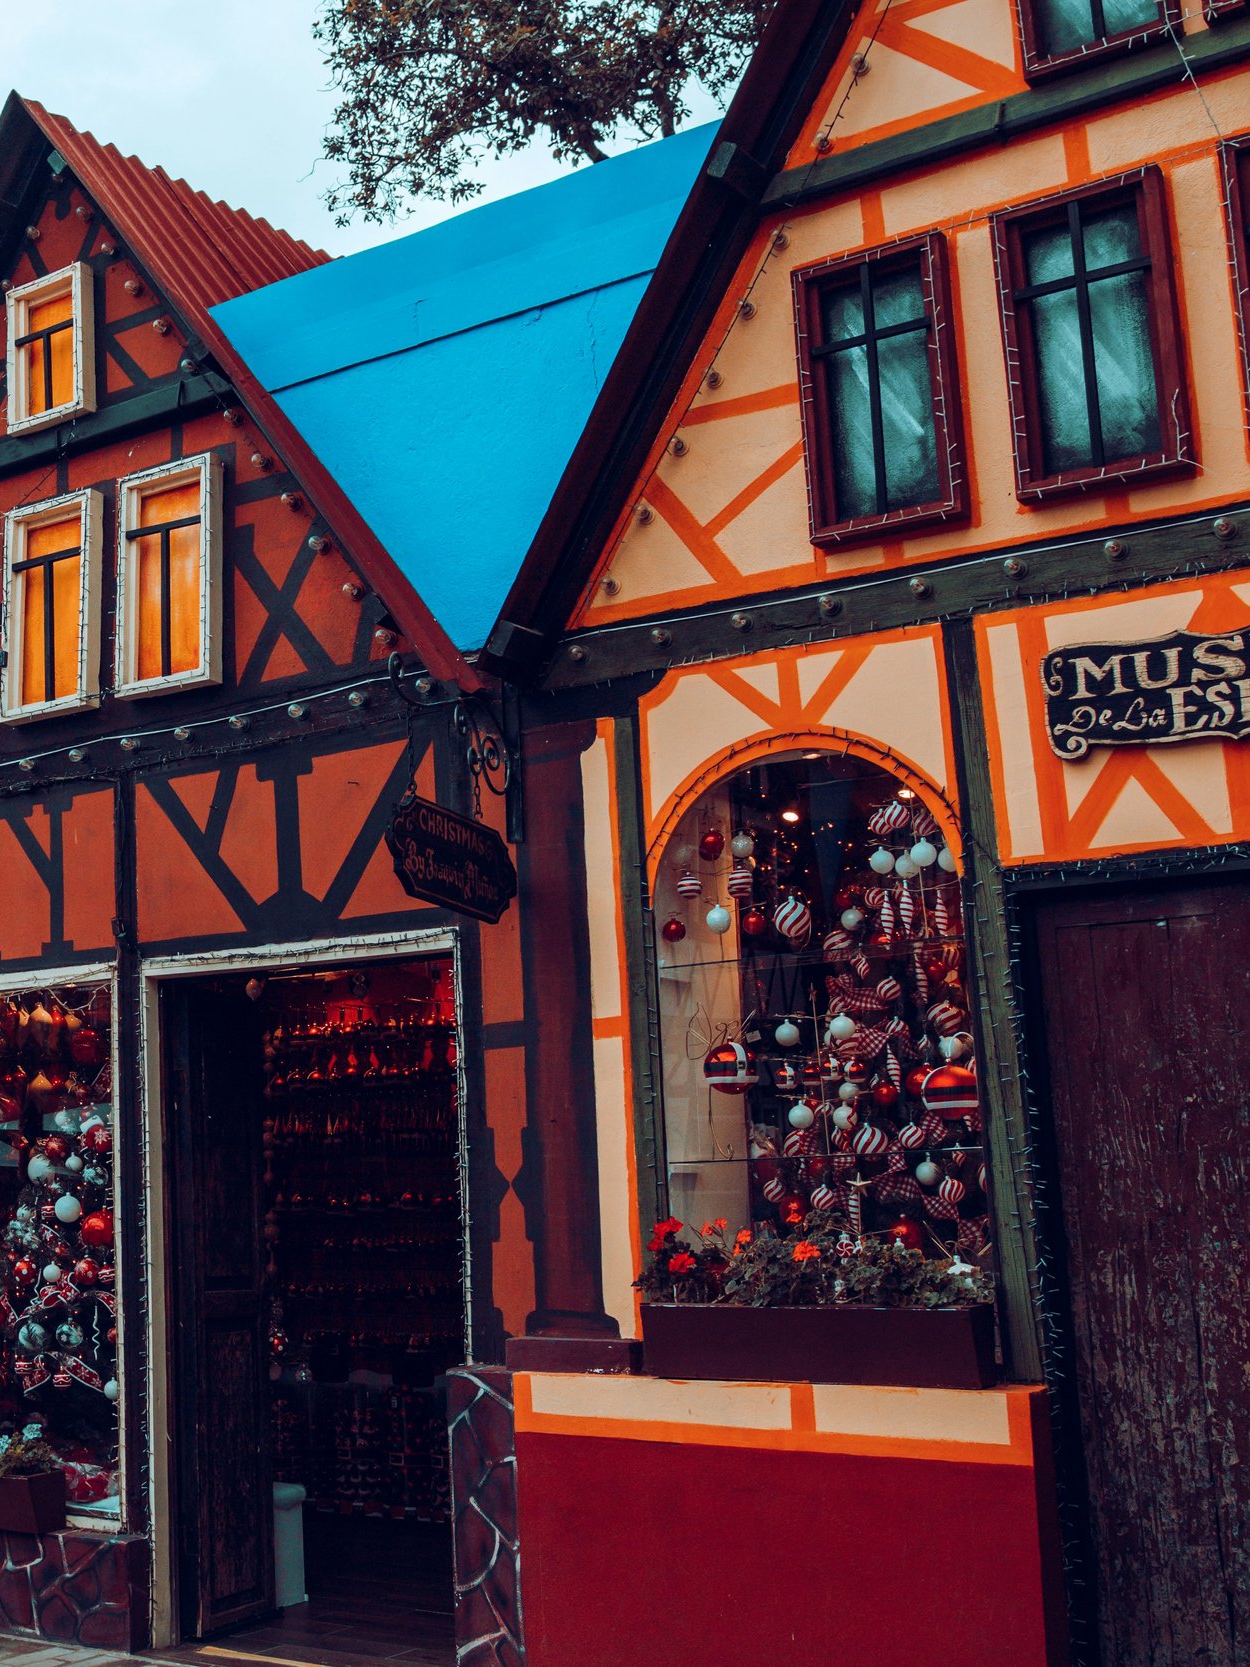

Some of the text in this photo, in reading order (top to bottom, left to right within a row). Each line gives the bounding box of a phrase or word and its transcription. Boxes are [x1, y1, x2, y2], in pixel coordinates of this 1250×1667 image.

[1053, 705, 1112, 735] De
[1112, 697, 1168, 731] La
[419, 808, 485, 855] CHRISTMAS
